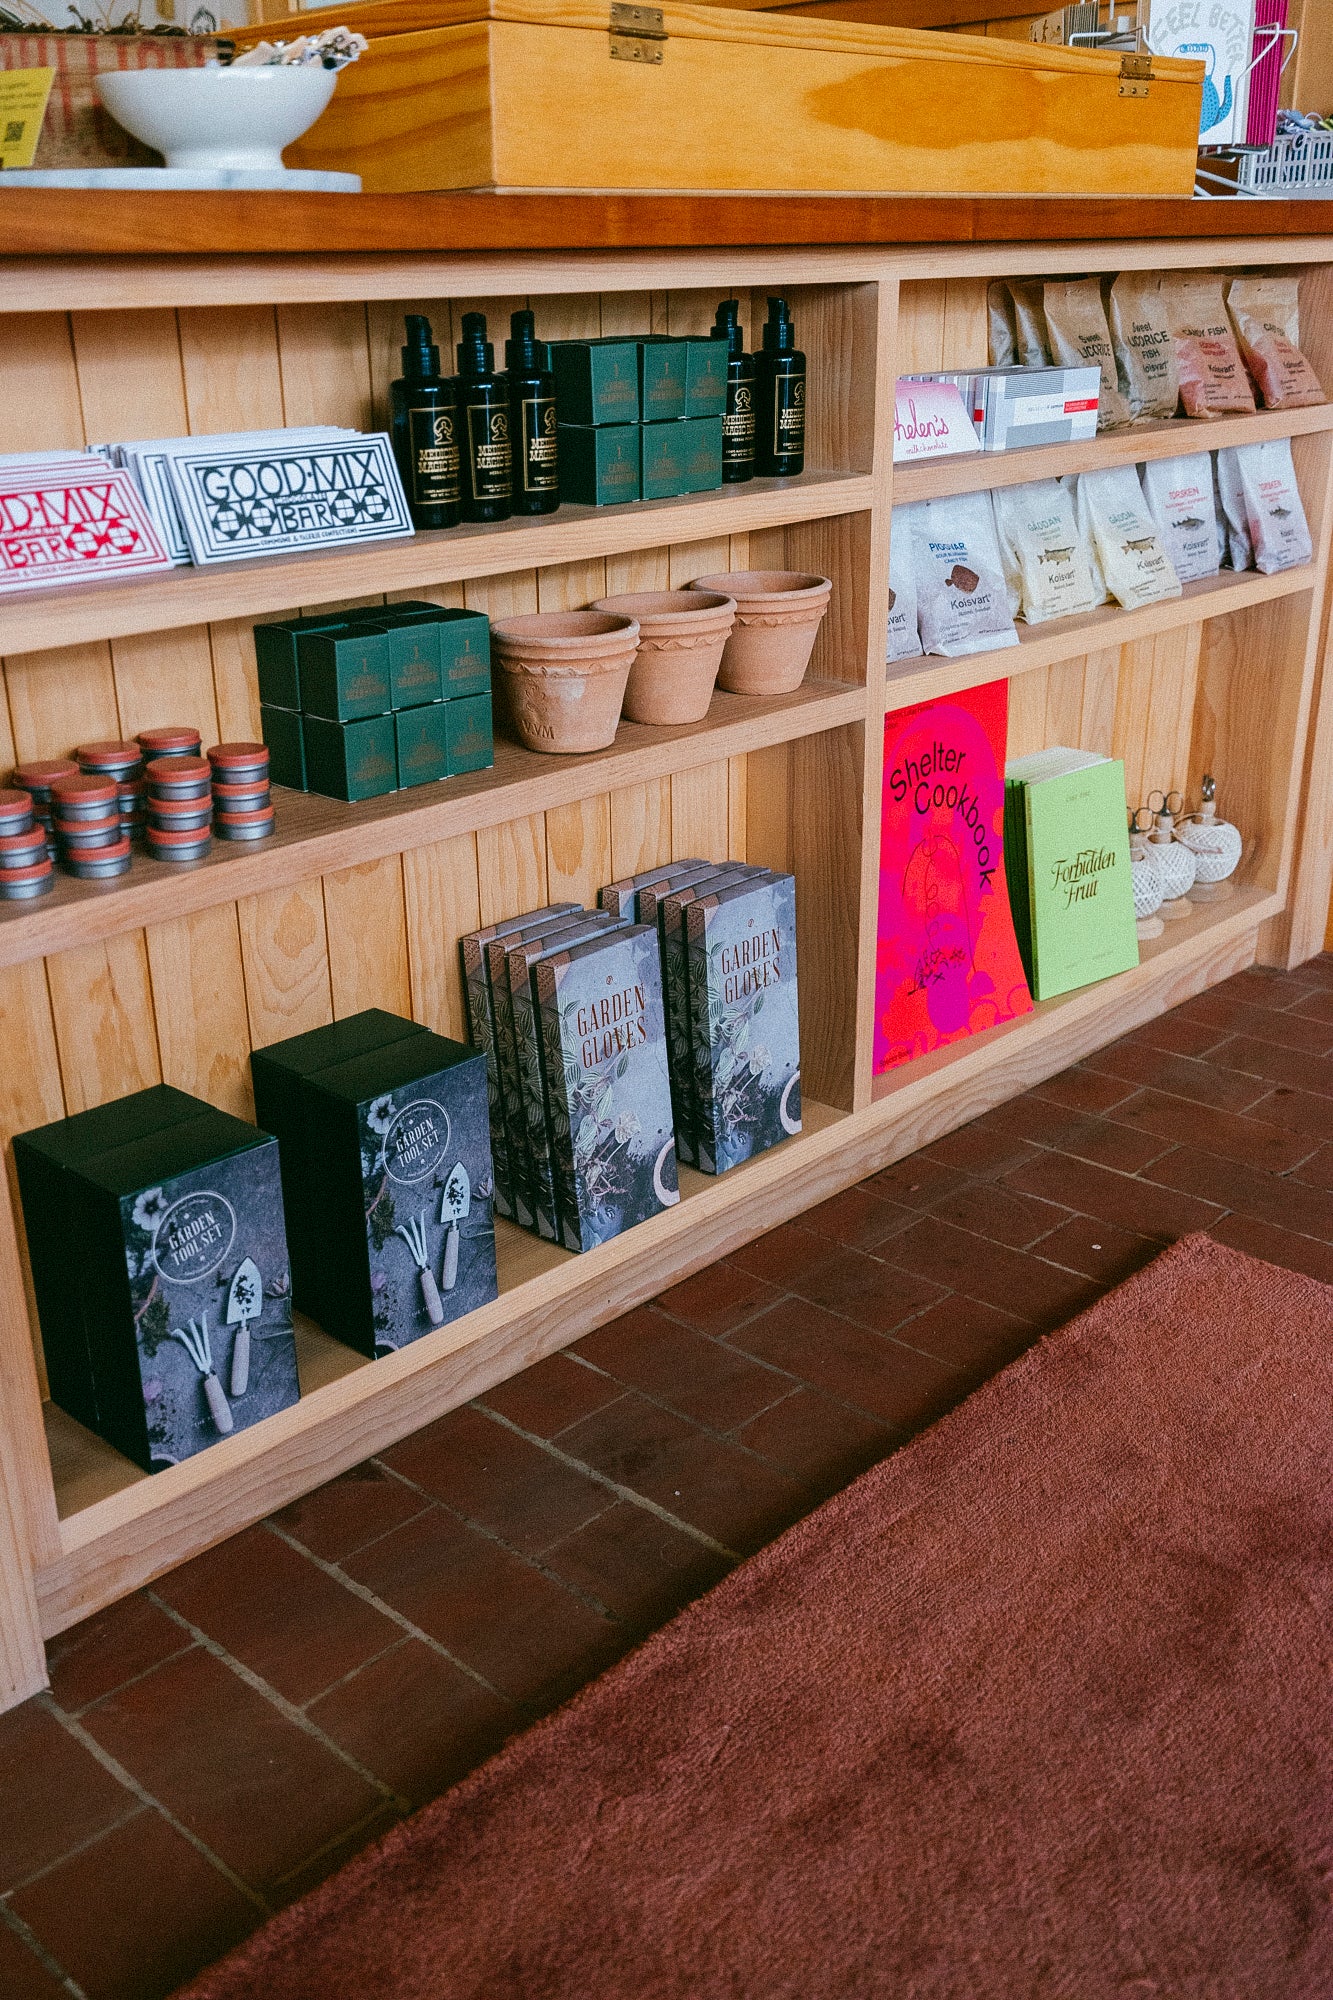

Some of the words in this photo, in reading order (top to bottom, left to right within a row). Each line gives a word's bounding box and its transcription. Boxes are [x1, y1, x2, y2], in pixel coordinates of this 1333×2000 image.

[1208, 326, 1228, 337] FISH
[1141, 348, 1161, 360] FISH
[893, 398, 950, 441] helen's
[282, 502, 334, 532] BAR
[5, 537, 74, 569] BAR
[889, 741, 967, 802] Shelter
[914, 781, 994, 888] Cookbook
[1051, 846, 1116, 890] Forbidden
[1064, 875, 1099, 910] Fruit
[721, 927, 781, 976] GARDEN
[724, 957, 782, 1006] GLOVES
[577, 982, 646, 1038] GARDEN
[581, 1016, 647, 1070] GLOVES
[396, 1117, 434, 1153] GARDEN
[397, 1144, 422, 1168] TOOL
[421, 1129, 439, 1152] SET
[168, 1210, 215, 1250] GARDEN
[171, 1239, 202, 1266] TOOL
[201, 1223, 222, 1248] SET
